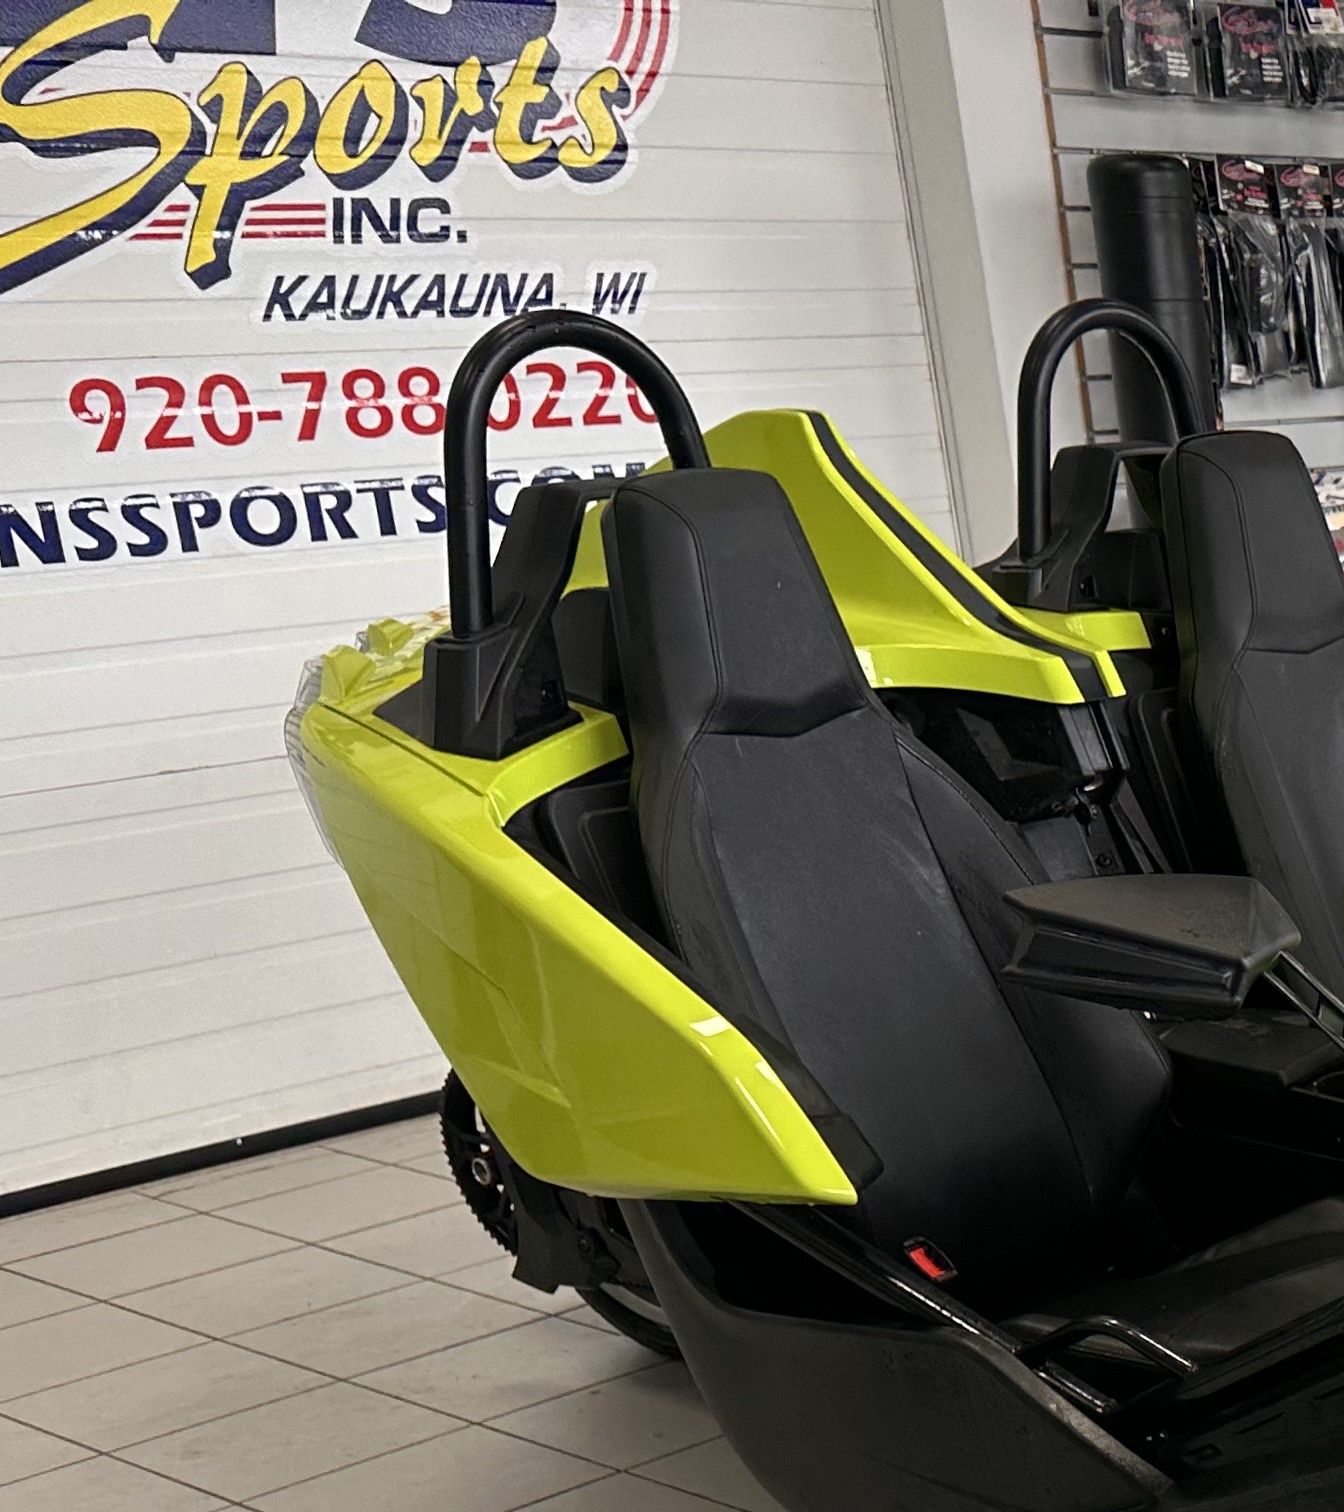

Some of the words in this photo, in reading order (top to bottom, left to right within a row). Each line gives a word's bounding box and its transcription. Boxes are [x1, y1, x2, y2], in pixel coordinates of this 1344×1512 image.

[0, 0, 640, 290] Sports
[333, 196, 468, 245] INC.
[591, 271, 648, 315] WI
[68, 361, 658, 453] 920-7880220
